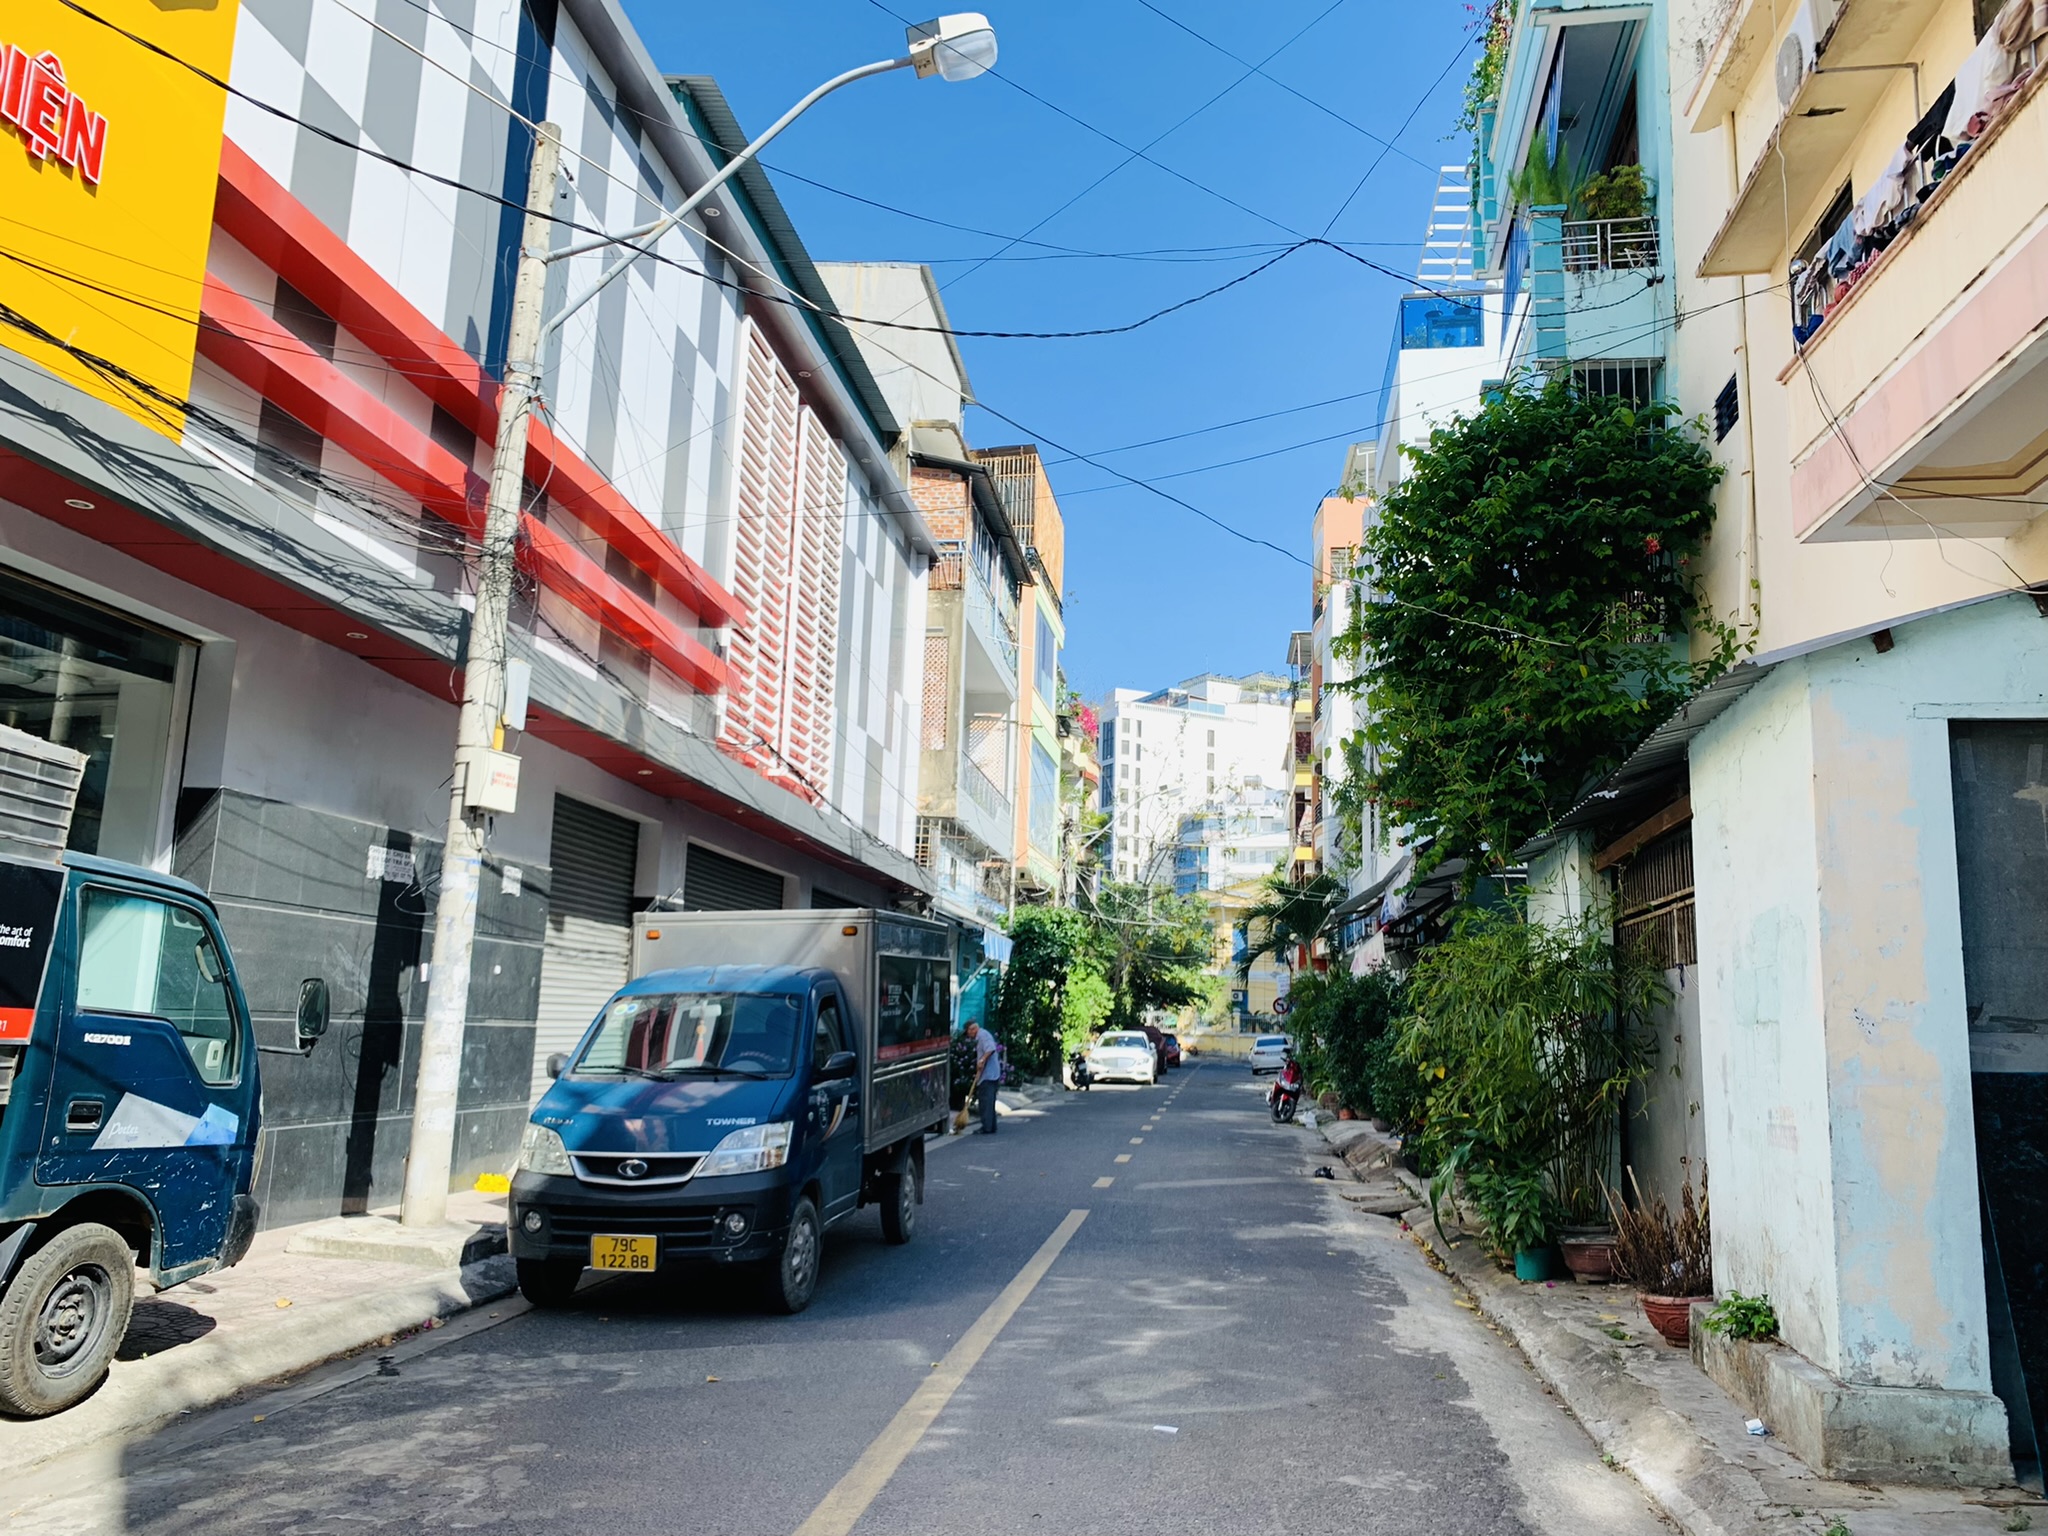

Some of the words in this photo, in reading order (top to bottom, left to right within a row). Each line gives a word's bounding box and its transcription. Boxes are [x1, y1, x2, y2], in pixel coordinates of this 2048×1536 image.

[11, 926, 23, 936] art
[23, 926, 34, 937] of
[705, 1117, 756, 1126] TOWNER
[611, 1238, 638, 1253] 79C
[601, 1253, 649, 1269] 122.88
